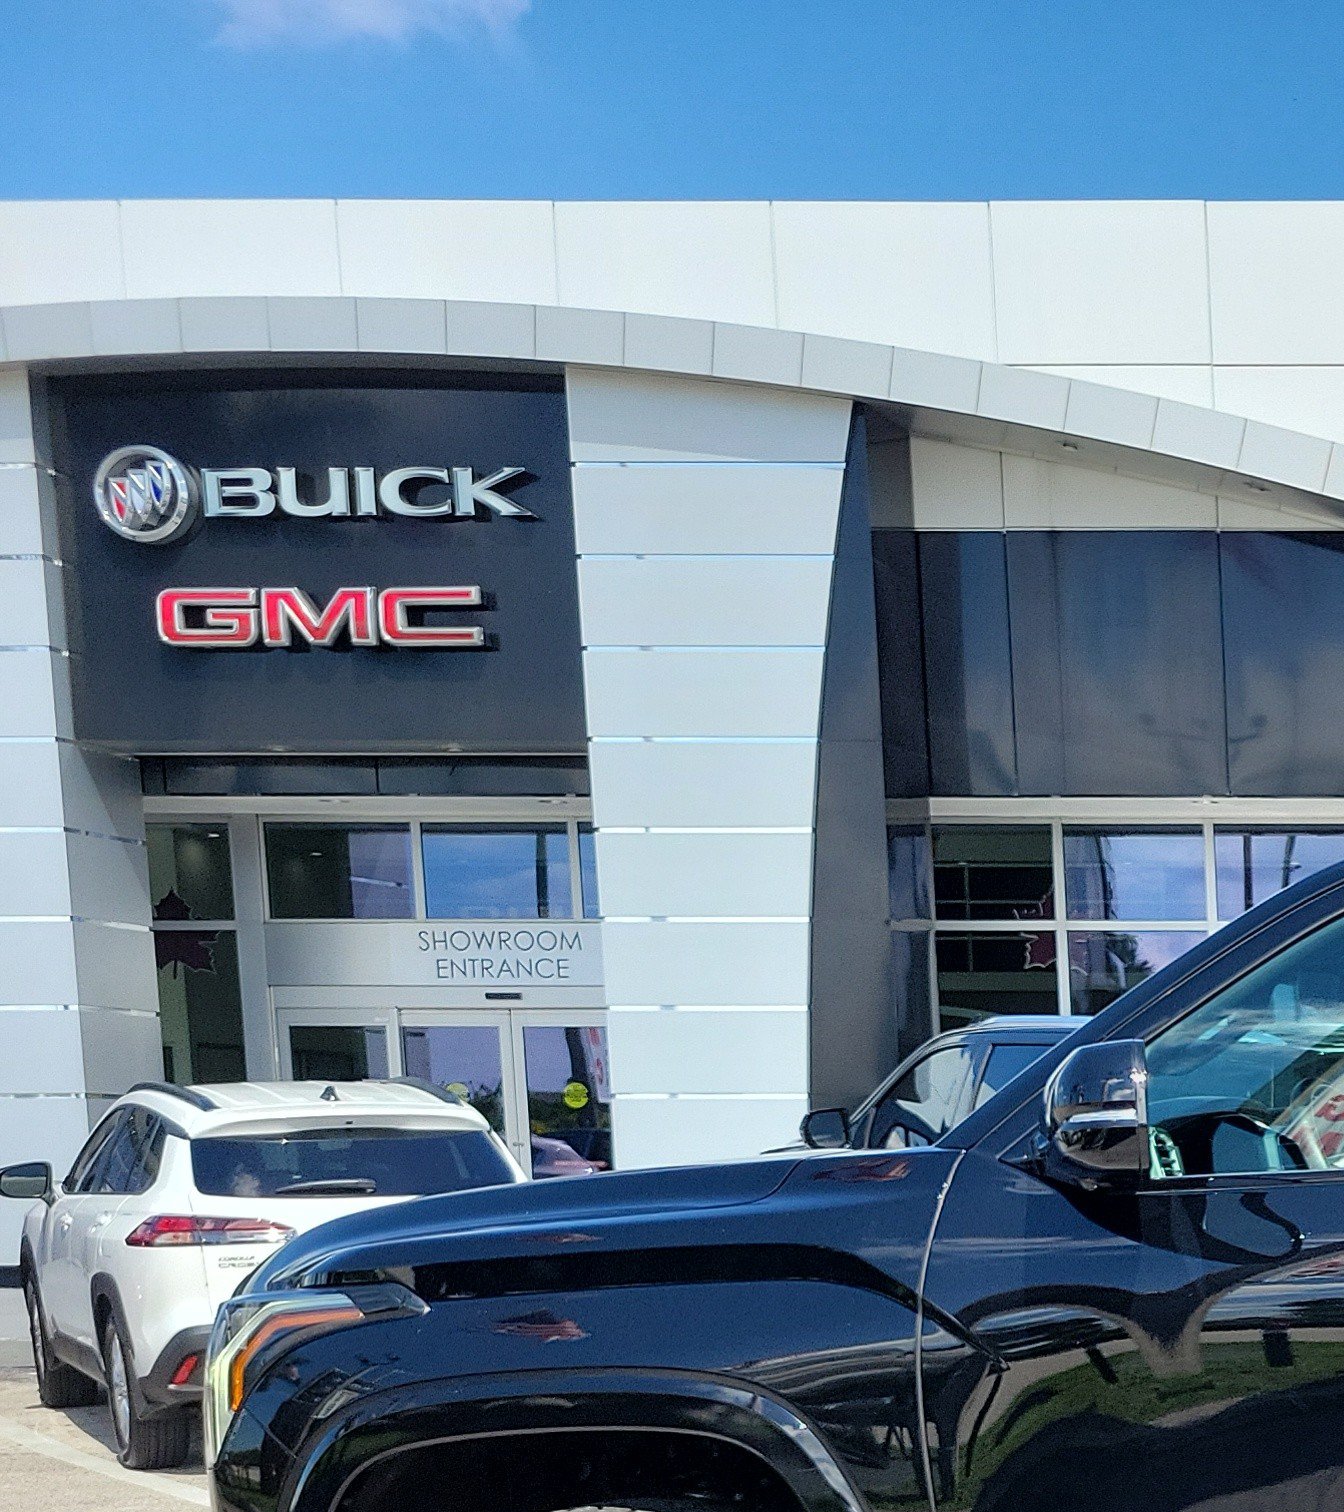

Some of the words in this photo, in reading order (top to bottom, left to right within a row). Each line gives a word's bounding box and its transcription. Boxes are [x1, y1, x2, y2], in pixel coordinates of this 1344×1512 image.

[202, 466, 540, 520] BUICK
[156, 585, 485, 648] GMC
[418, 930, 583, 952] SHOWROOM
[435, 957, 570, 979] ENTRANCE
